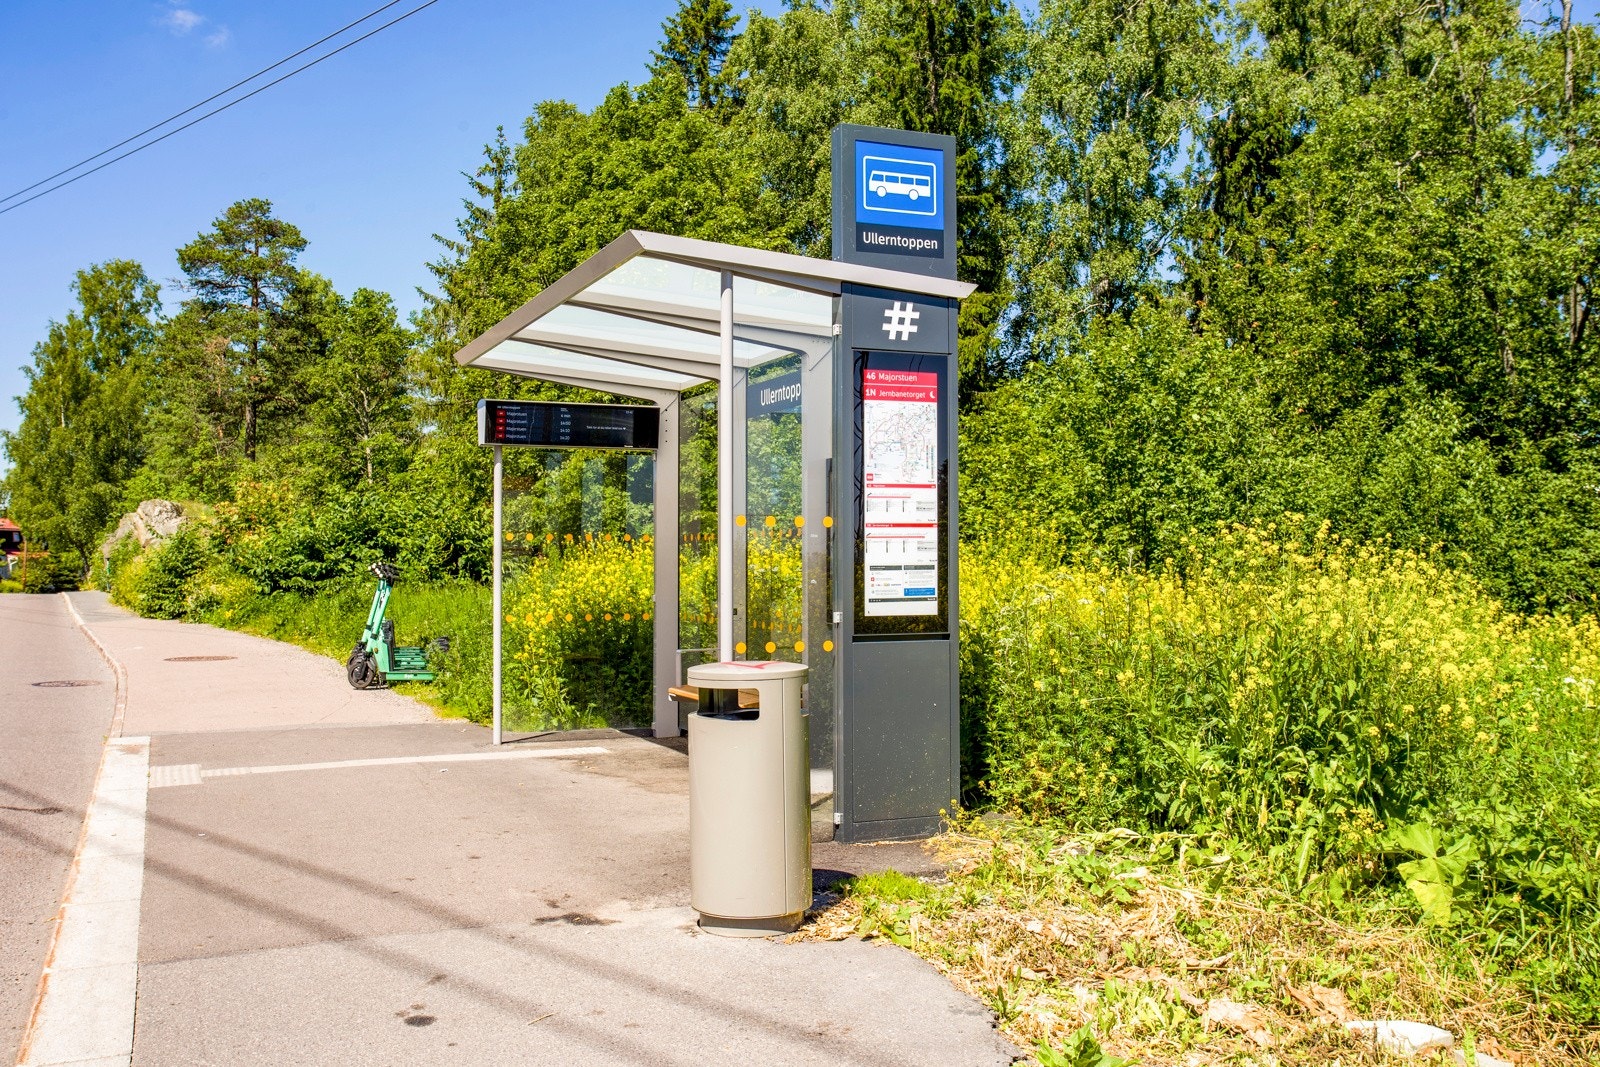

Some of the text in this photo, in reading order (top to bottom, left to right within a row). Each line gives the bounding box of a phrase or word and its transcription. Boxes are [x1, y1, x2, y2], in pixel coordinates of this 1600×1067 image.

[862, 231, 938, 251] Ullerntoppen
[866, 372, 918, 382] 46 Majorstuen
[865, 388, 926, 399] 1N Jernbanetorget
